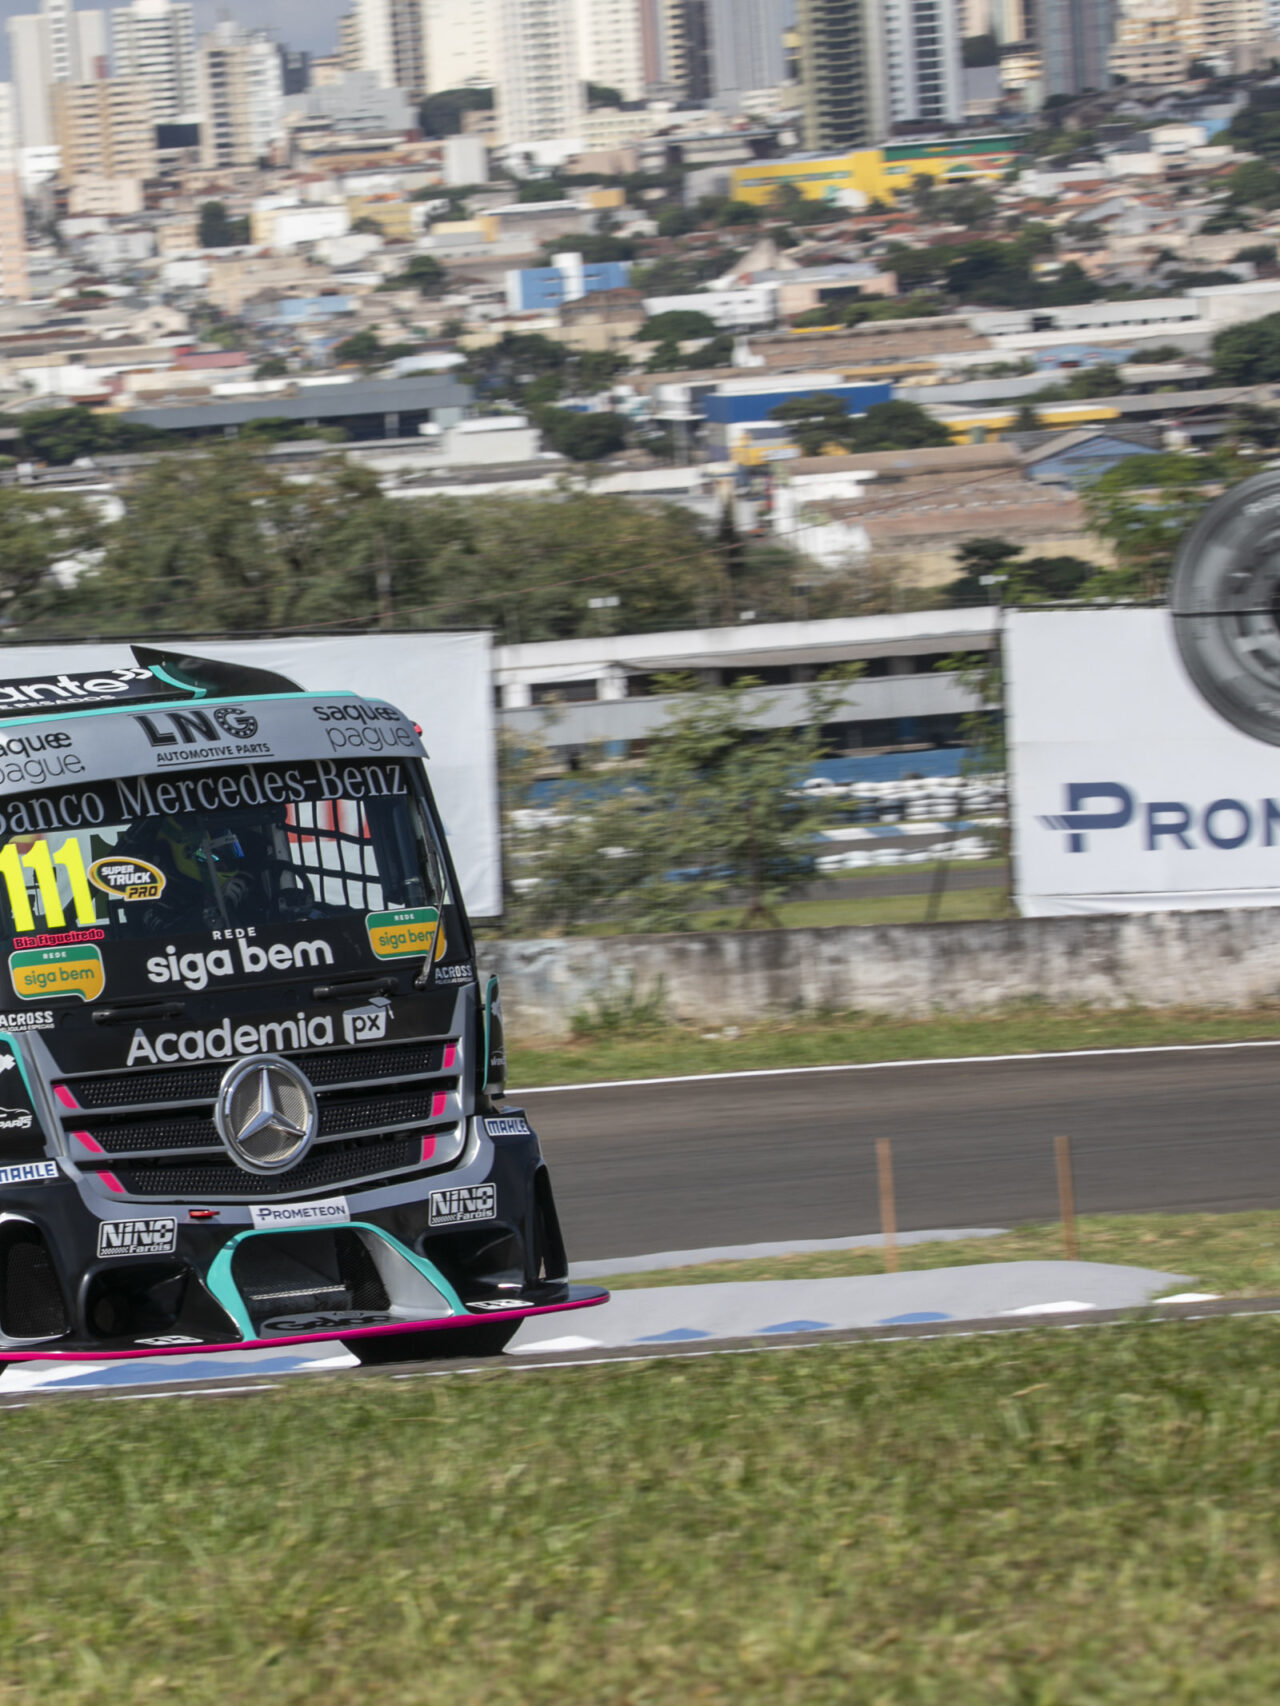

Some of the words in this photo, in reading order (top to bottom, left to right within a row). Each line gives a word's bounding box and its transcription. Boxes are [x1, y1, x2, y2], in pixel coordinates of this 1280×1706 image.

[132, 706, 259, 747] LNG
[156, 744, 234, 763] AUTOMOTIVE
[235, 742, 271, 756] PARTS
[113, 759, 408, 820] Mercedes-Benz
[101, 864, 135, 876] SUPER
[107, 871, 151, 887] TRUCK
[128, 885, 158, 899] PRO
[393, 913, 415, 921] REDE
[13, 937, 36, 950] Bia
[36, 928, 105, 947] Figueiredo
[213, 926, 257, 941] REDE
[378, 931, 407, 949] siga
[42, 951, 67, 960] REDE
[146, 945, 235, 991] siga
[237, 937, 335, 973] bem
[23, 970, 57, 988] siga
[58, 966, 95, 982] bem
[434, 965, 473, 980] ACROSS
[126, 1011, 335, 1067] Academia
[352, 1014, 381, 1035] px
[486, 1119, 527, 1134] MAHLE
